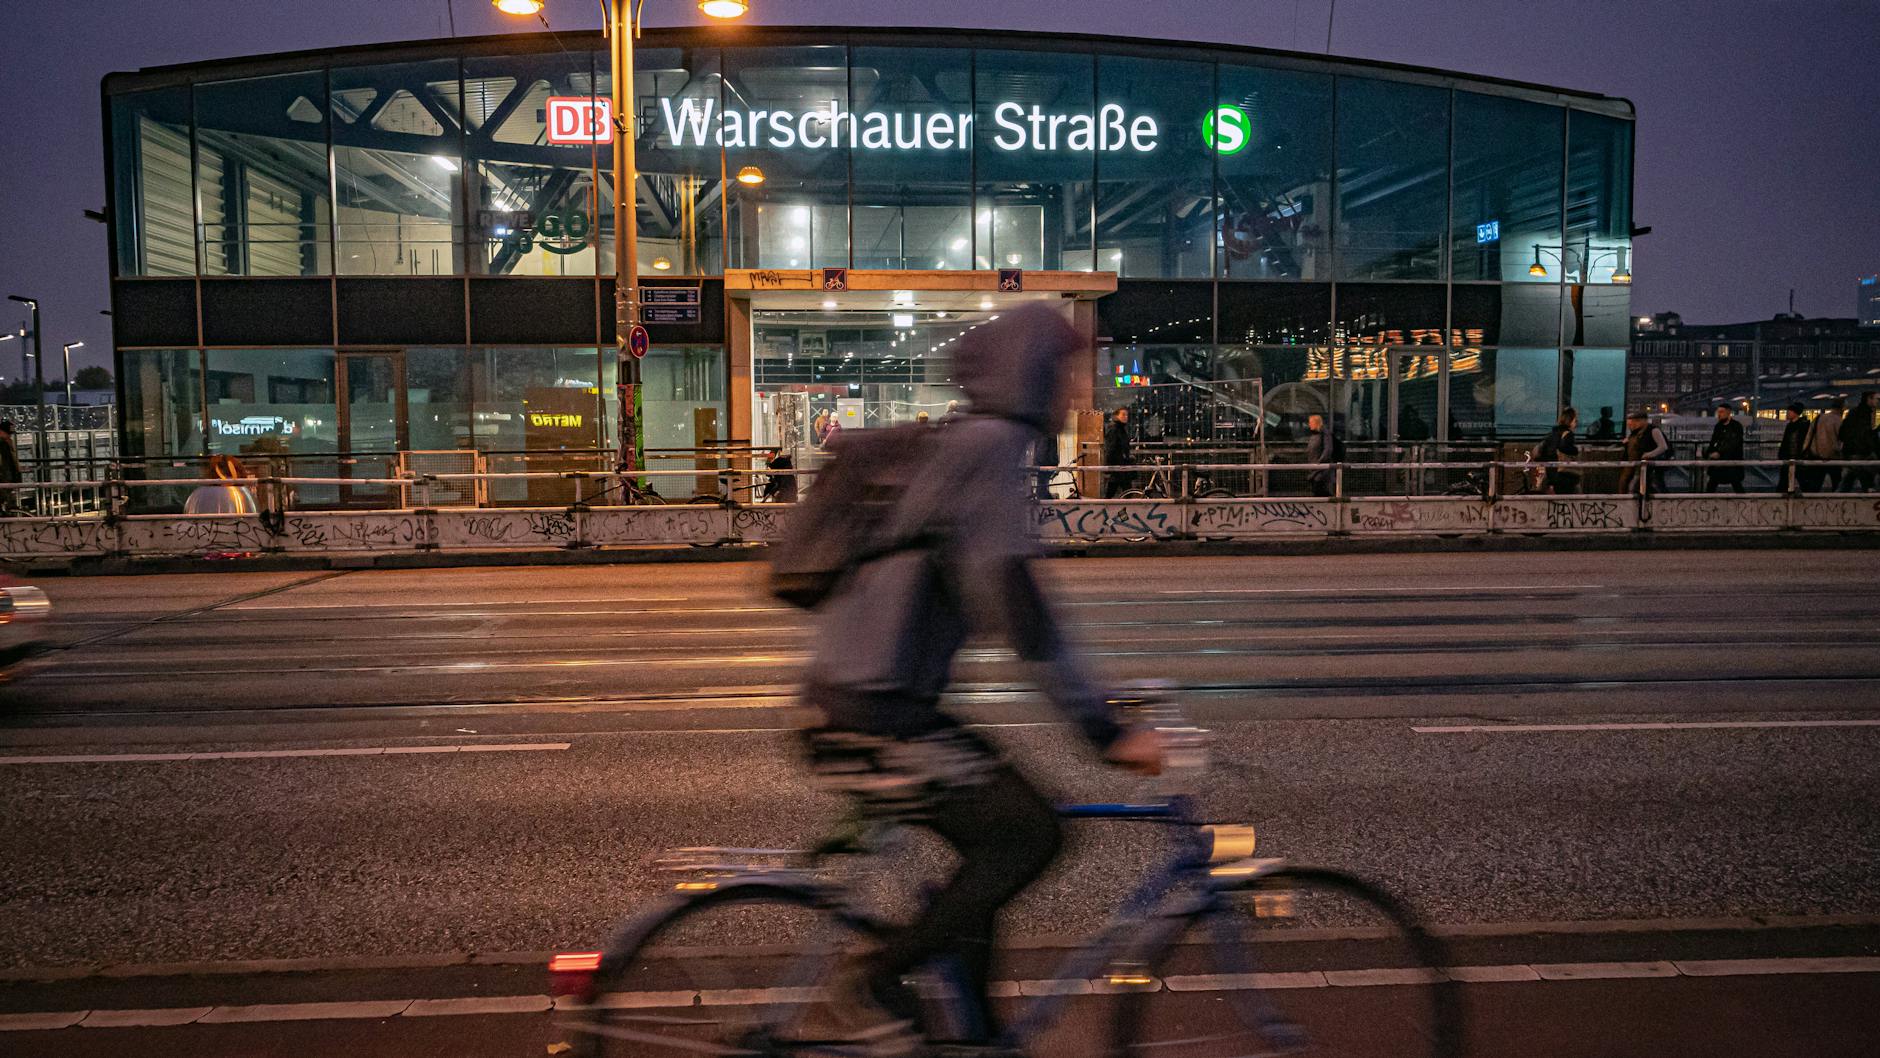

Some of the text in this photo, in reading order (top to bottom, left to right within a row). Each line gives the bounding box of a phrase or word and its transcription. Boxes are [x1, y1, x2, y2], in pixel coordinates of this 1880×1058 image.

[555, 105, 604, 136] DB
[661, 97, 1159, 152] Warschauer Straße
[1209, 107, 1244, 151] S
